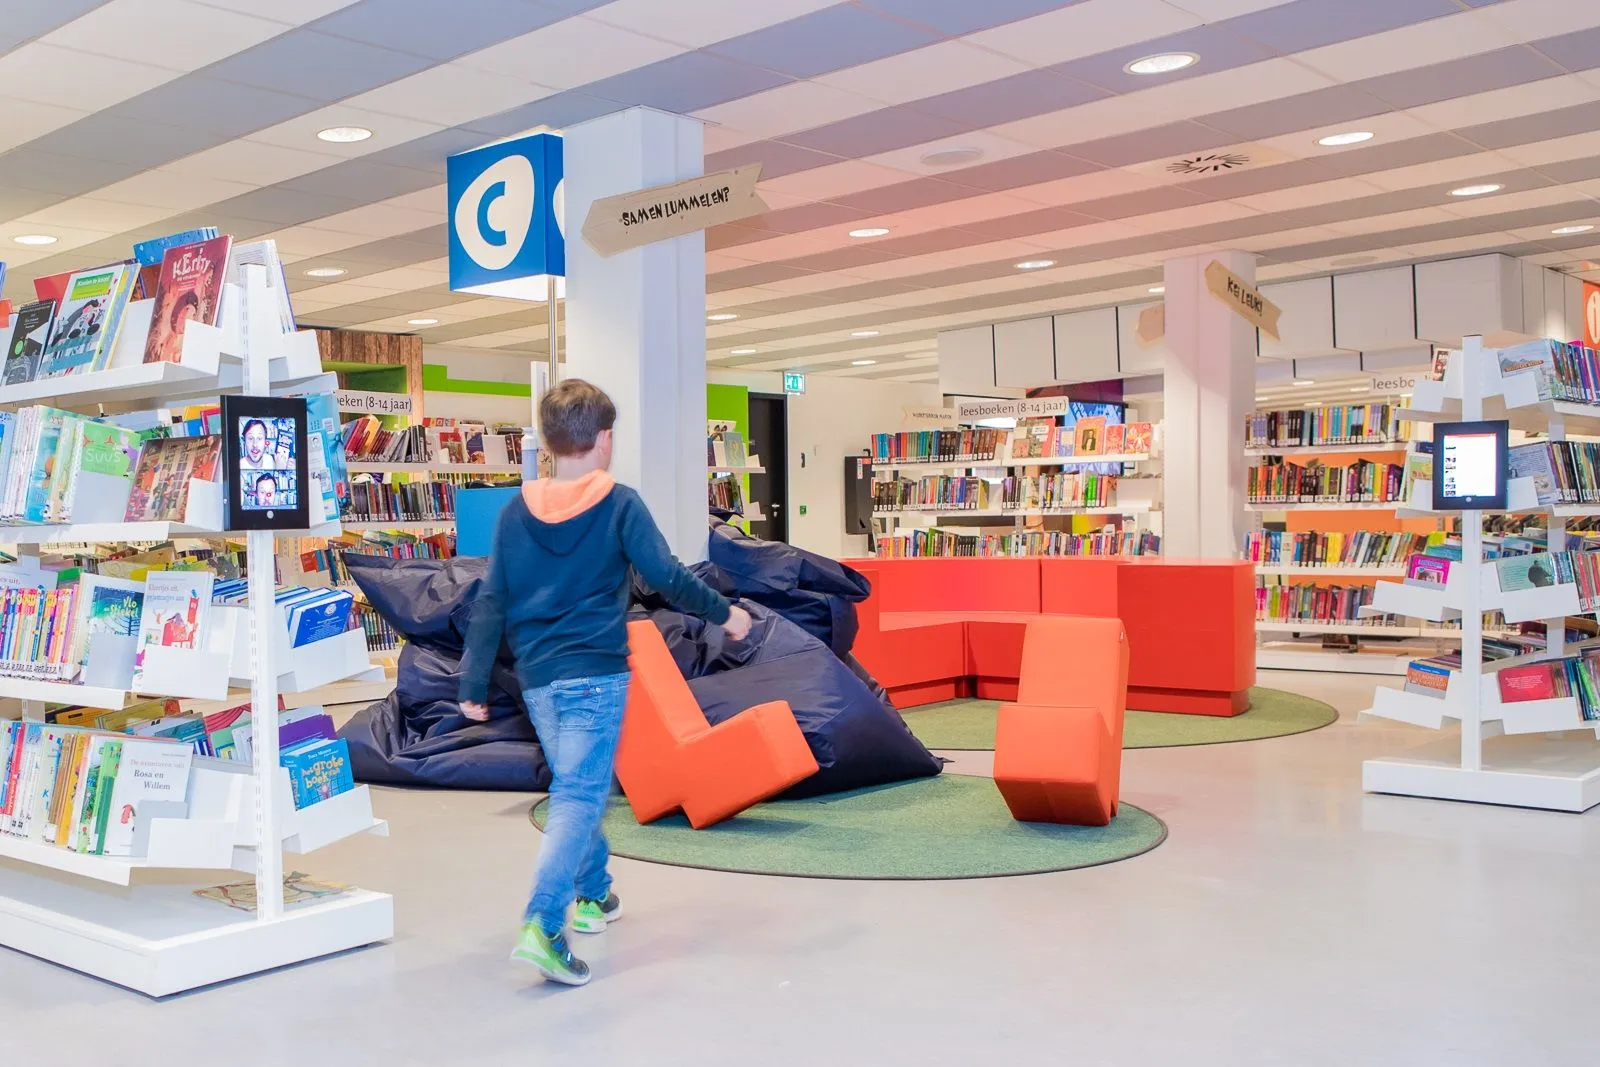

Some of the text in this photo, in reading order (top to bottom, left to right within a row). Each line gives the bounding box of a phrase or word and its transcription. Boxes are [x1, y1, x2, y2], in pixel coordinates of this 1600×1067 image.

[477, 180, 507, 247] C
[622, 186, 730, 226] SAMEN LUMMELEN?
[365, 395, 389, 411] (8-14
[389, 397, 412, 413] jaar)
[960, 402, 1014, 416] leesboeken
[1016, 401, 1040, 415] (8-14
[1042, 398, 1067, 413] jaar)
[134, 769, 153, 778] Rosa
[313, 755, 344, 777] grote
[144, 780, 171, 791] Willem
[305, 770, 330, 789] boek
